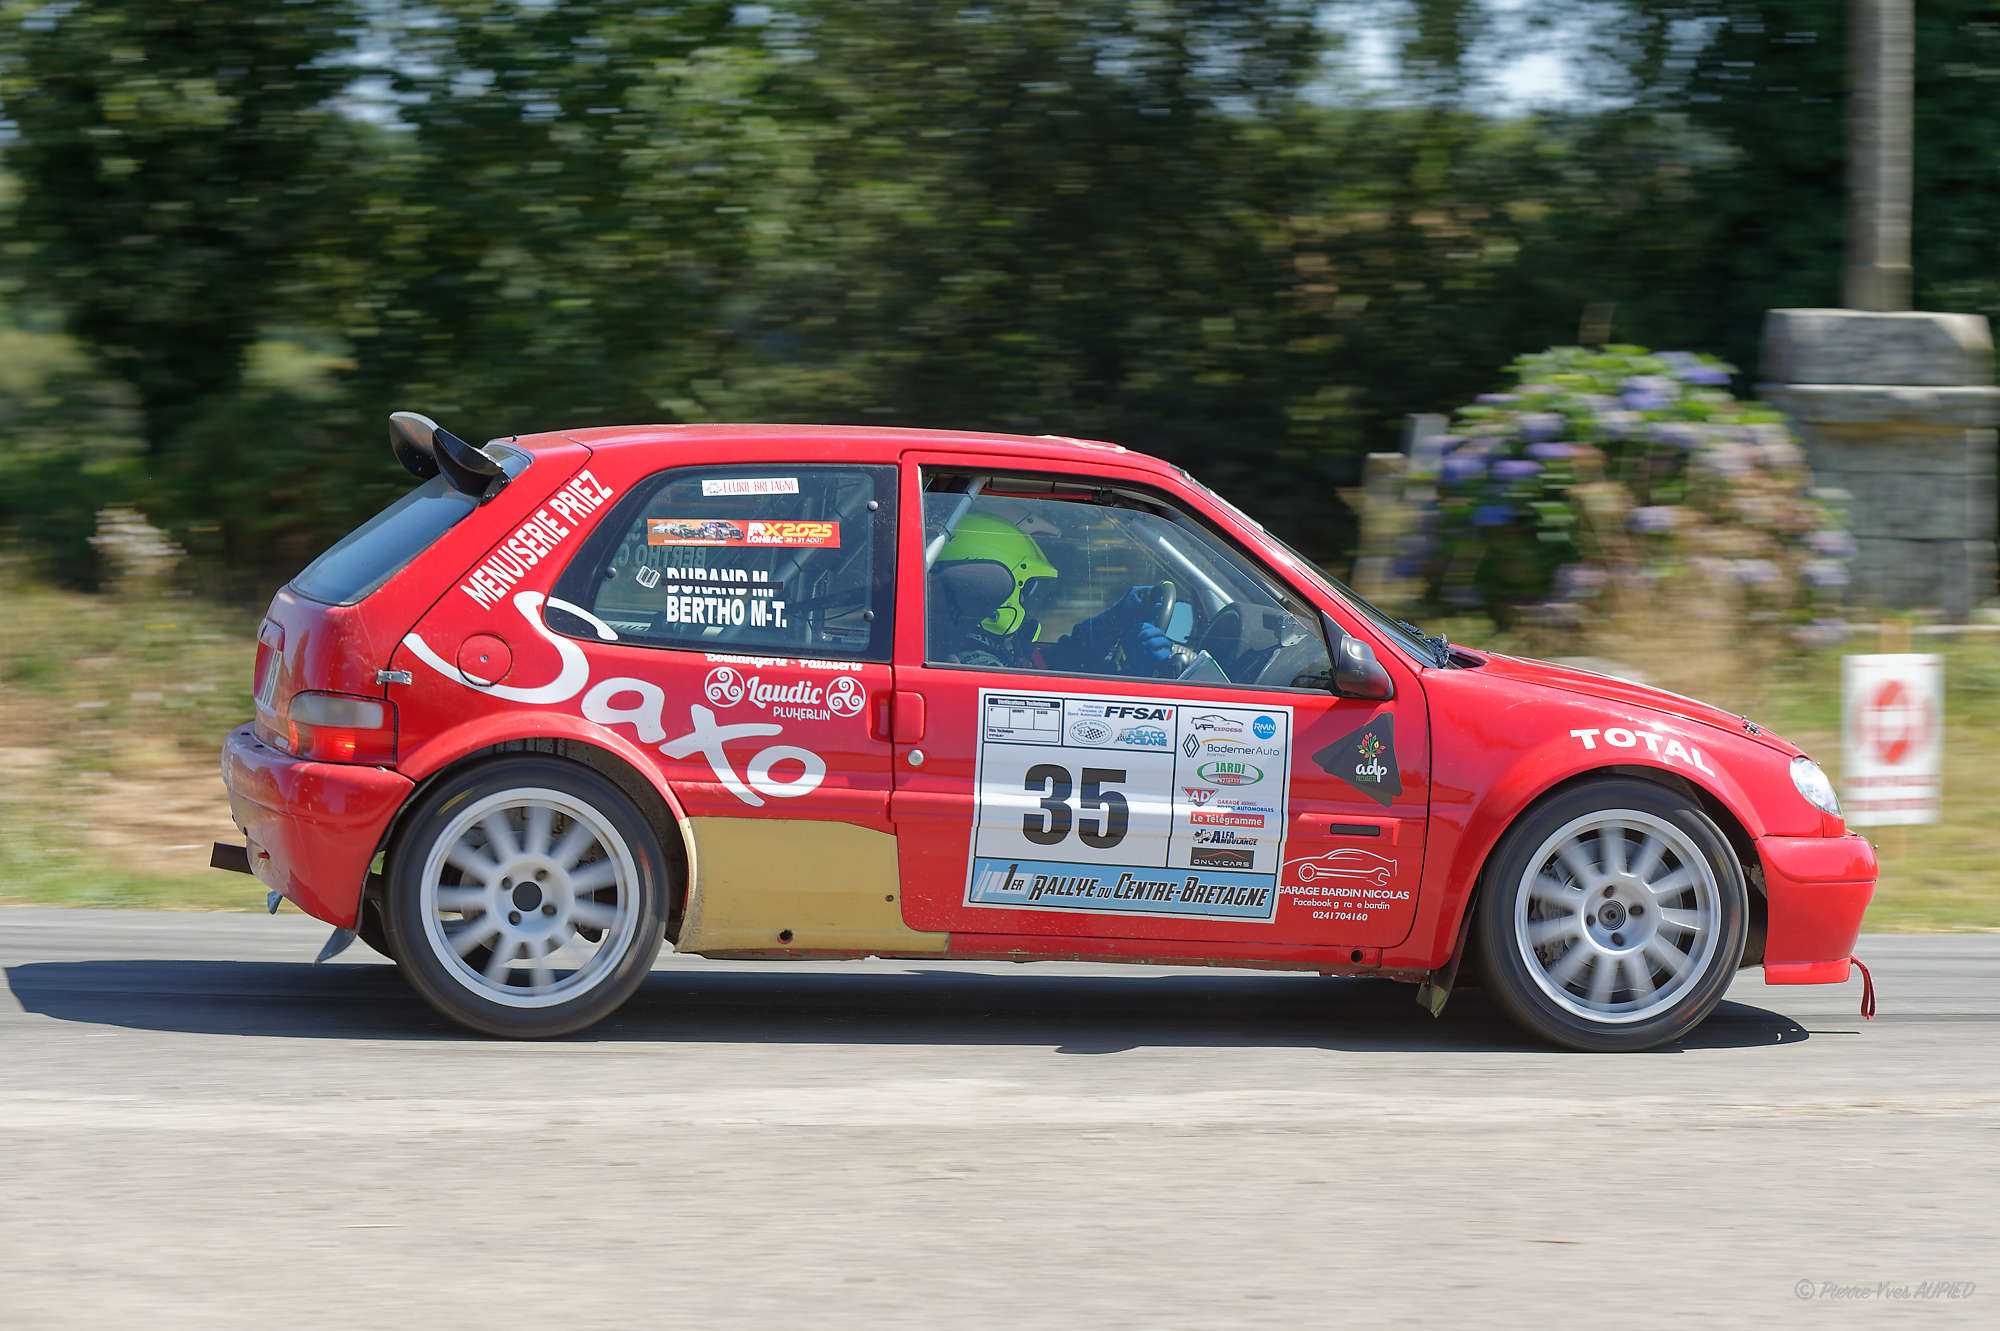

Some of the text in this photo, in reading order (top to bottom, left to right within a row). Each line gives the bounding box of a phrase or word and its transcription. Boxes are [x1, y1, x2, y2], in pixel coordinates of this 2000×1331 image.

[747, 522, 833, 538] RX2025
[460, 469, 614, 611] MENUISERIE PRIEZ
[666, 567, 774, 597] DURAND M.
[666, 595, 788, 628] BERTHO M-T.
[403, 589, 827, 808] Saxo
[746, 675, 823, 709] Laudic
[773, 706, 831, 721] PLUHERLIN
[1104, 706, 1165, 720] FFSA
[1253, 722, 1275, 734] RMN
[1569, 727, 1716, 778] TOTAL
[1215, 762, 1246, 775] JARDI
[1355, 757, 1388, 784] adp
[1190, 790, 1211, 803] AD
[1022, 763, 1130, 850] 35
[1192, 814, 1263, 827] Le Télégramme
[1193, 858, 1250, 868] ONLY CARS
[1028, 874, 1099, 901] RALLYE
[1096, 887, 1113, 899] DU
[1113, 872, 1271, 908] CENTRE-BRETAGNE
[1279, 886, 1410, 900] GARAGE BARDIN NICOLAS
[1293, 898, 1332, 908] Facebook
[1364, 900, 1391, 910] bardin
[1312, 910, 1368, 921] 0241704160
